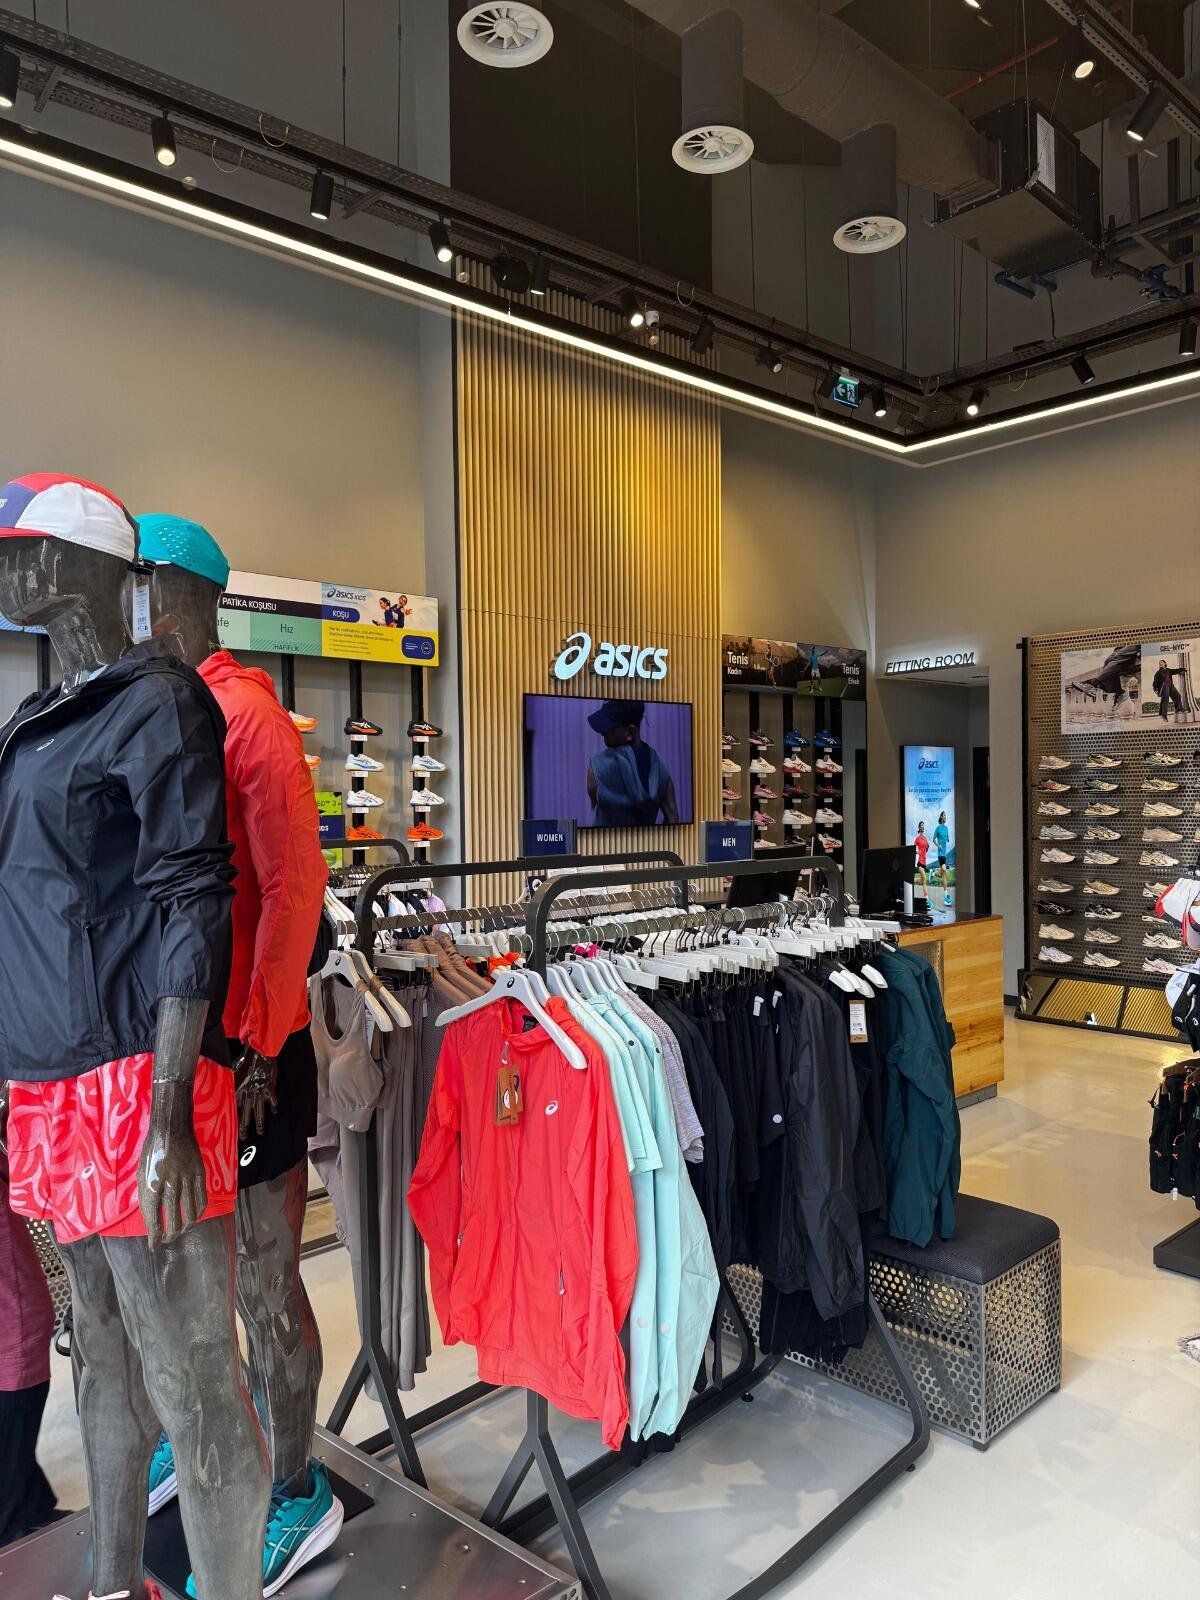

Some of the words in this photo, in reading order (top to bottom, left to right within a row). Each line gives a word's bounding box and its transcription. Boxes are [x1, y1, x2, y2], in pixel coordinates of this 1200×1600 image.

[222, 597, 247, 608] PATİKA
[249, 600, 277, 611] KOŞUSU
[332, 610, 350, 620] KOŞU
[727, 650, 749, 665] Tenis
[885, 657, 931, 673] FITTING
[935, 651, 975, 667] ROOM
[841, 662, 860, 675] Tenis
[536, 833, 564, 842] WOMEN
[722, 837, 736, 847] MEN
